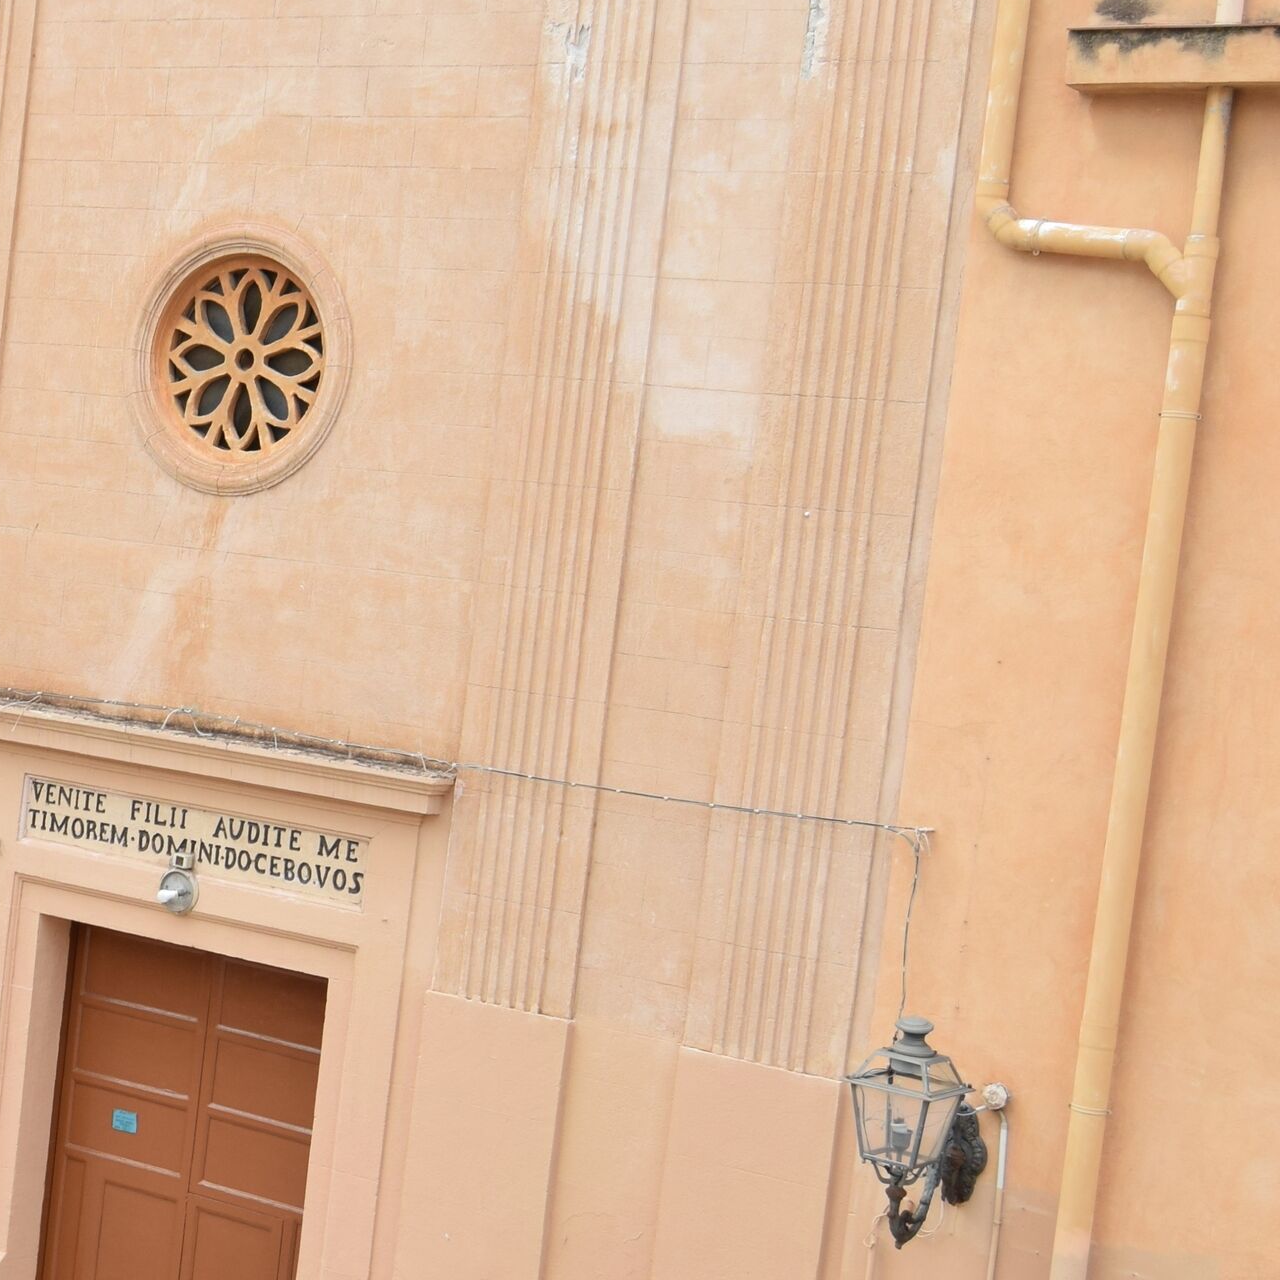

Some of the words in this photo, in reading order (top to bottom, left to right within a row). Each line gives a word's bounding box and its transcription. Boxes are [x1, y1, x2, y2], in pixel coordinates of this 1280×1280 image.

[32, 780, 107, 814] VENITE
[130, 799, 189, 830] FILII
[212, 816, 302, 852] AUDITE
[317, 835, 360, 863] ME
